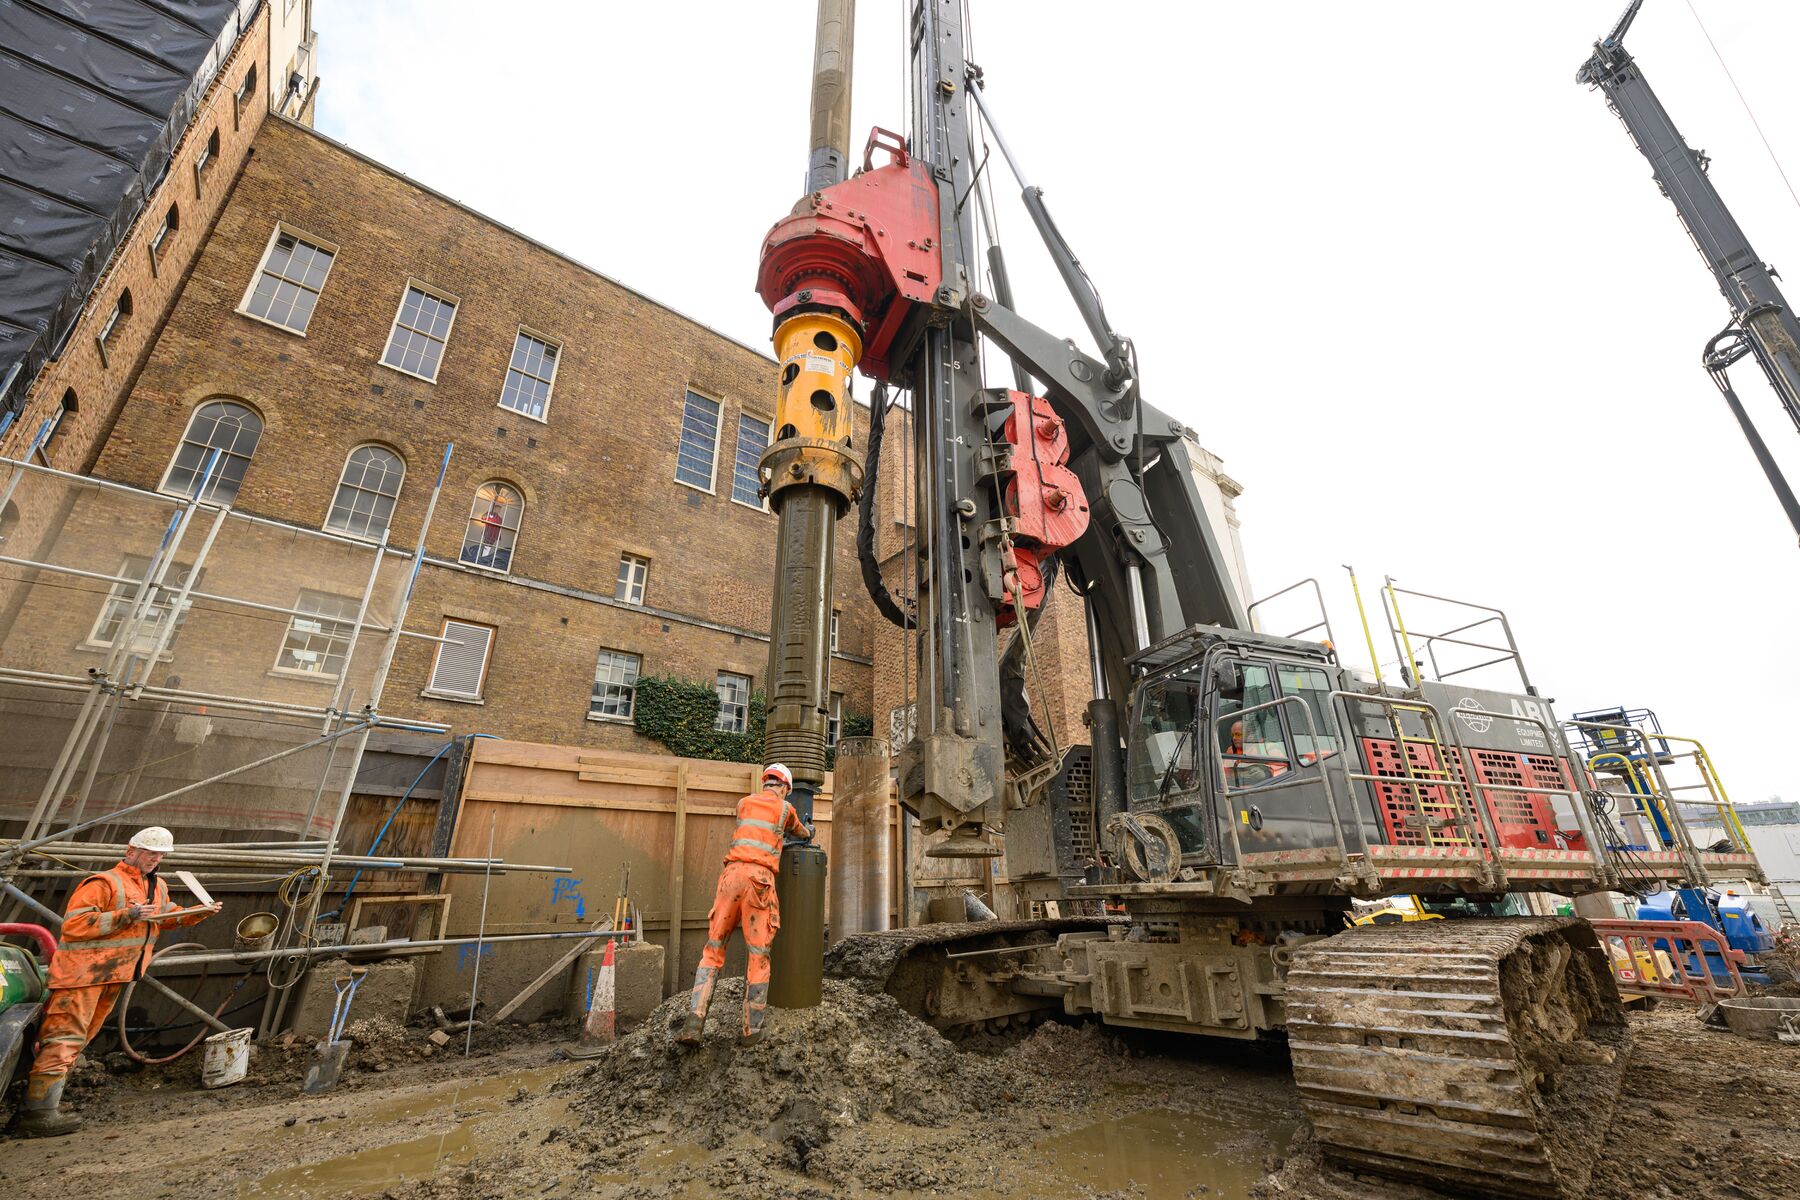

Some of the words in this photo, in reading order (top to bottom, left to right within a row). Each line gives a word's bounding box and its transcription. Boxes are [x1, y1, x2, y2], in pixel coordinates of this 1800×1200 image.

[953, 360, 961, 370] 5
[955, 435, 963, 445] 4
[960, 521, 967, 533] 3
[1510, 699, 1553, 729] ABI
[1516, 728, 1544, 739] EQUIPME
[1520, 738, 1544, 748] LIMITED
